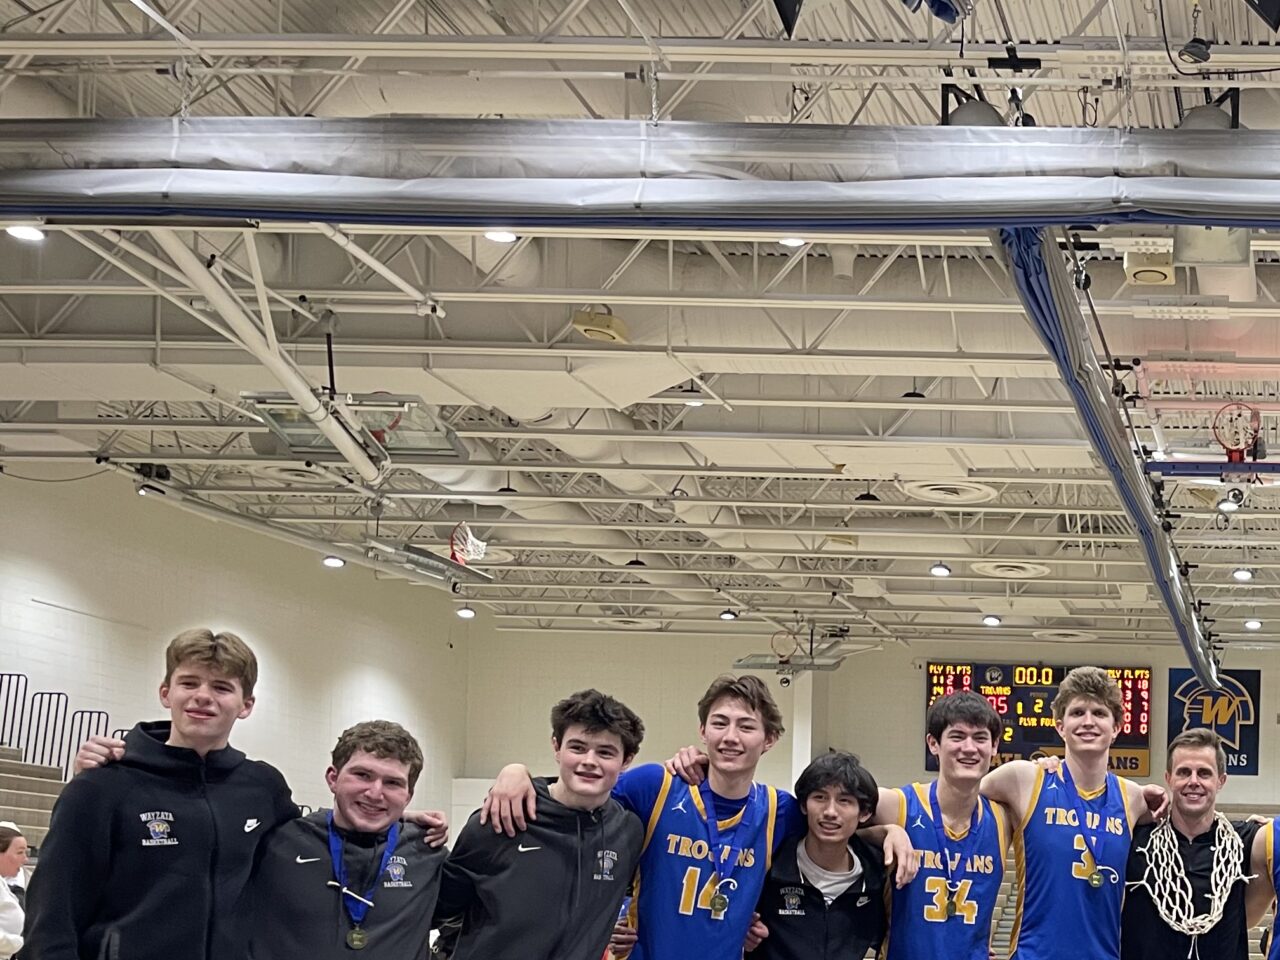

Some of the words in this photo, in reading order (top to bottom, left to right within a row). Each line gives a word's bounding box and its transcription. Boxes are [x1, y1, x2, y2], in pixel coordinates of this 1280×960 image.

[929, 665, 943, 674] PLY
[946, 666, 955, 674] FL
[957, 666, 971, 675] PTS
[1015, 667, 1053, 685] 00.0
[1135, 670, 1150, 679] PTS
[980, 686, 1011, 695] TROJANS
[1034, 699, 1044, 713] 2
[1003, 727, 1014, 741] 2
[140, 811, 174, 822] WAYZATA
[142, 838, 179, 846] BASKETBALL
[679, 866, 729, 920] 14
[924, 876, 978, 925] 34
